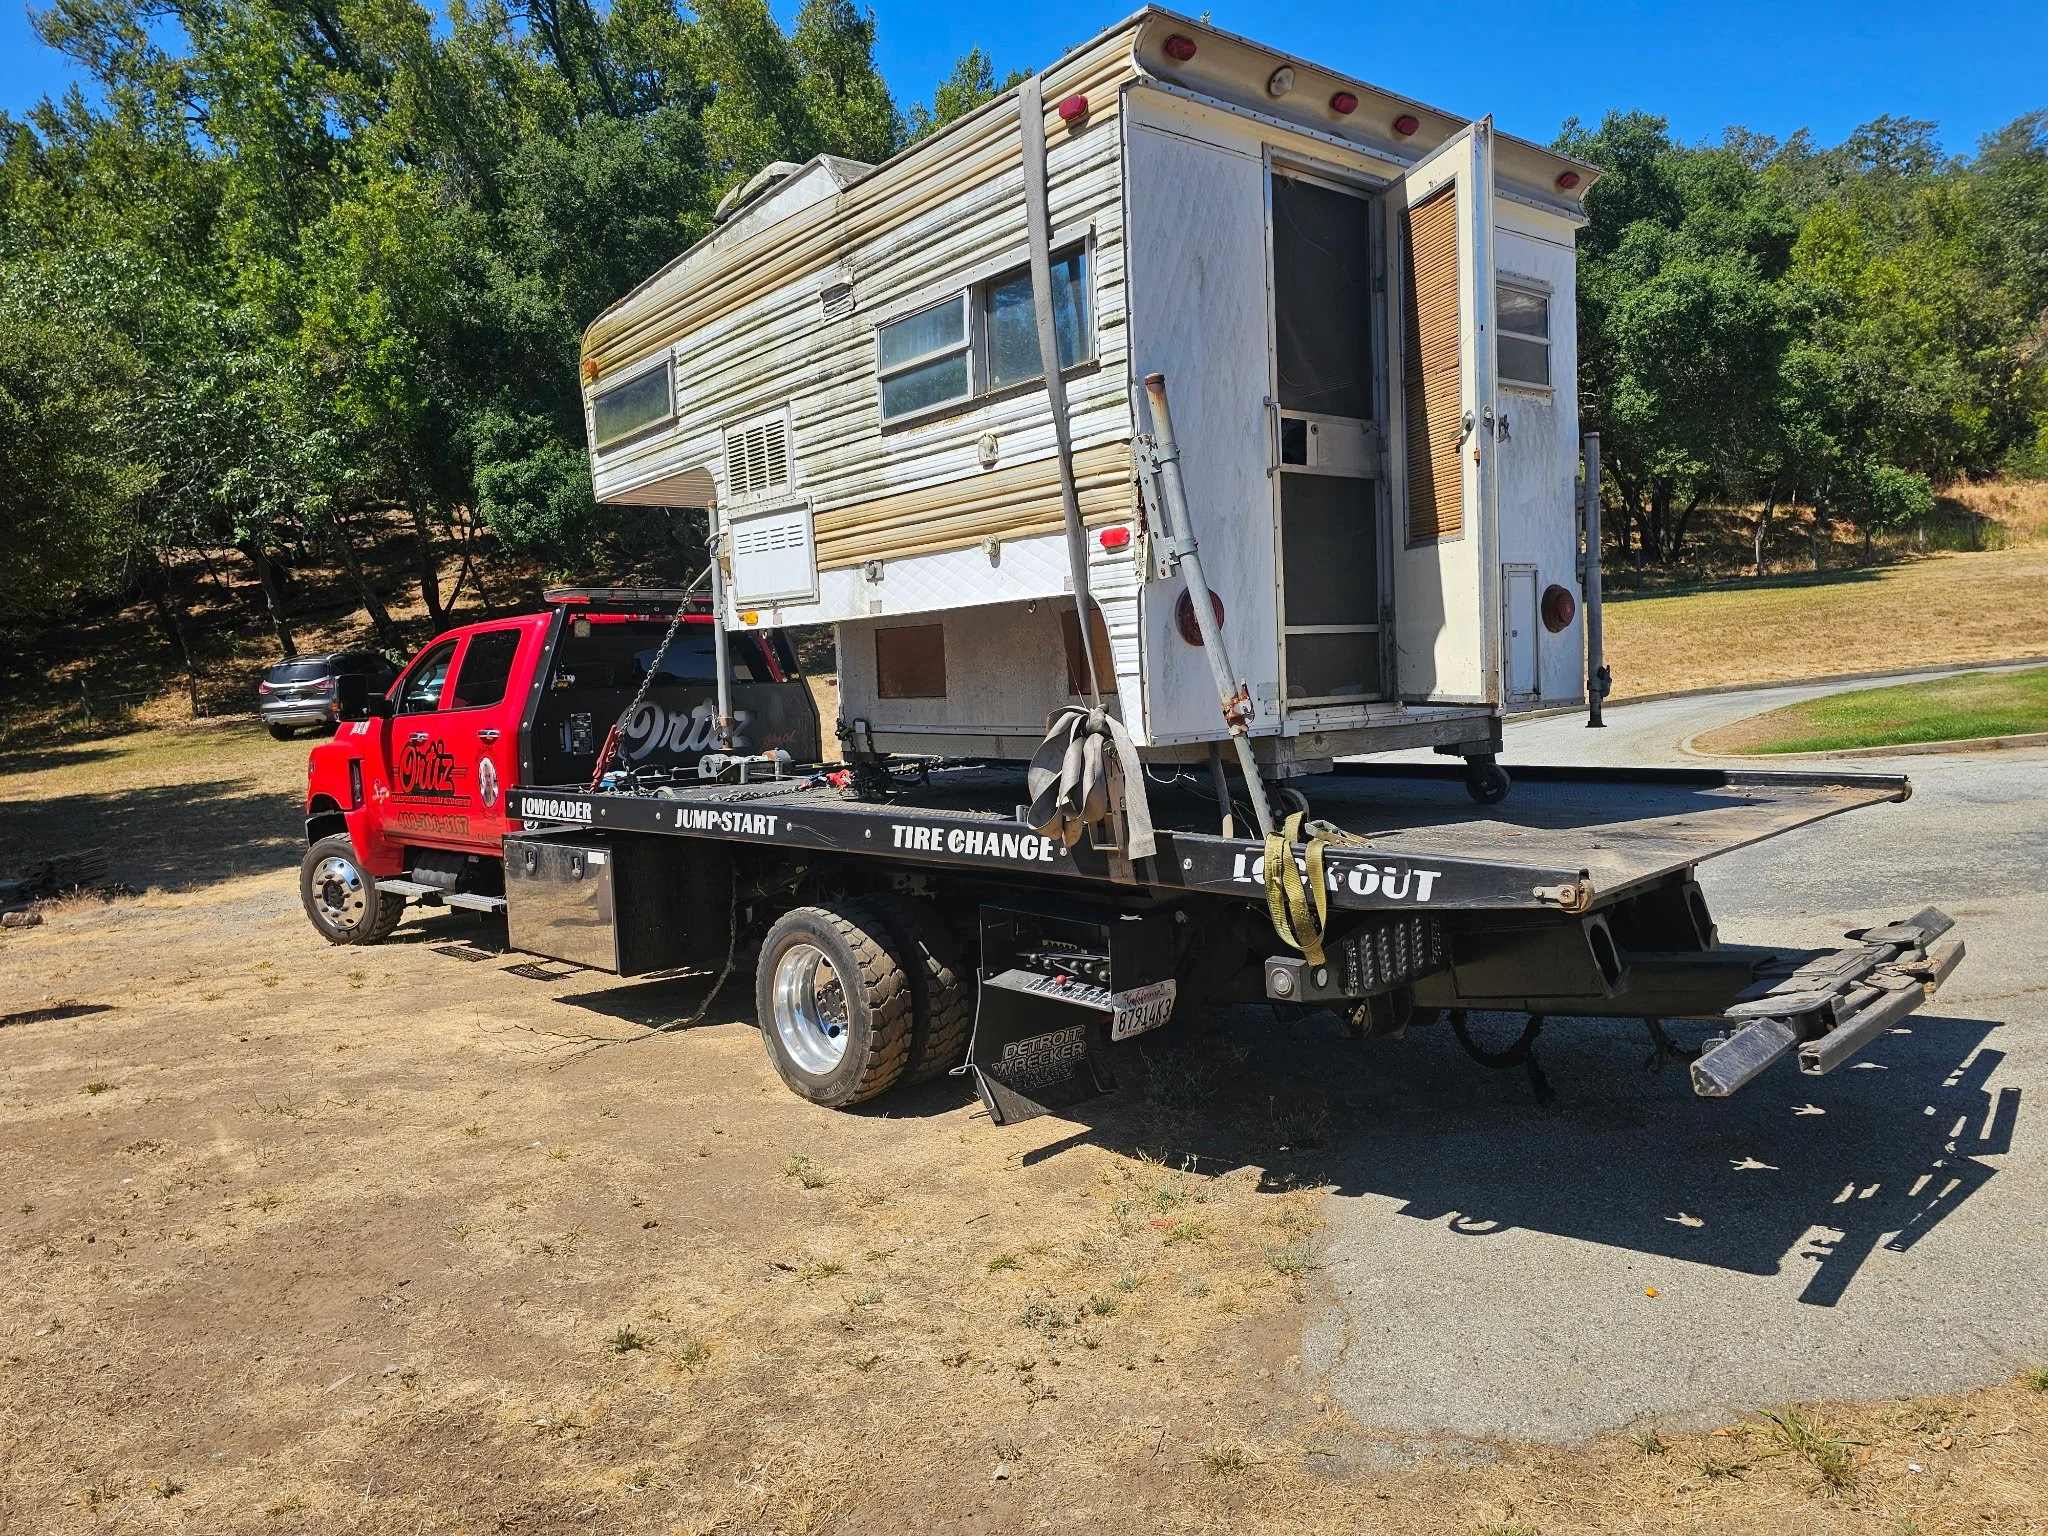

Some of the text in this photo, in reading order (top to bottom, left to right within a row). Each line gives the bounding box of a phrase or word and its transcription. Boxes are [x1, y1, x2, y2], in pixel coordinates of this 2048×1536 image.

[616, 698, 755, 760] Ortz
[401, 739, 455, 794] Ortiz
[892, 825, 1054, 861] TIRE CHANGE
[1349, 864, 1442, 901] OUT
[1119, 999, 1171, 1032] 87914K3
[992, 1041, 1086, 1078] WRECKER
[1003, 1025, 1084, 1060] DETROIT
